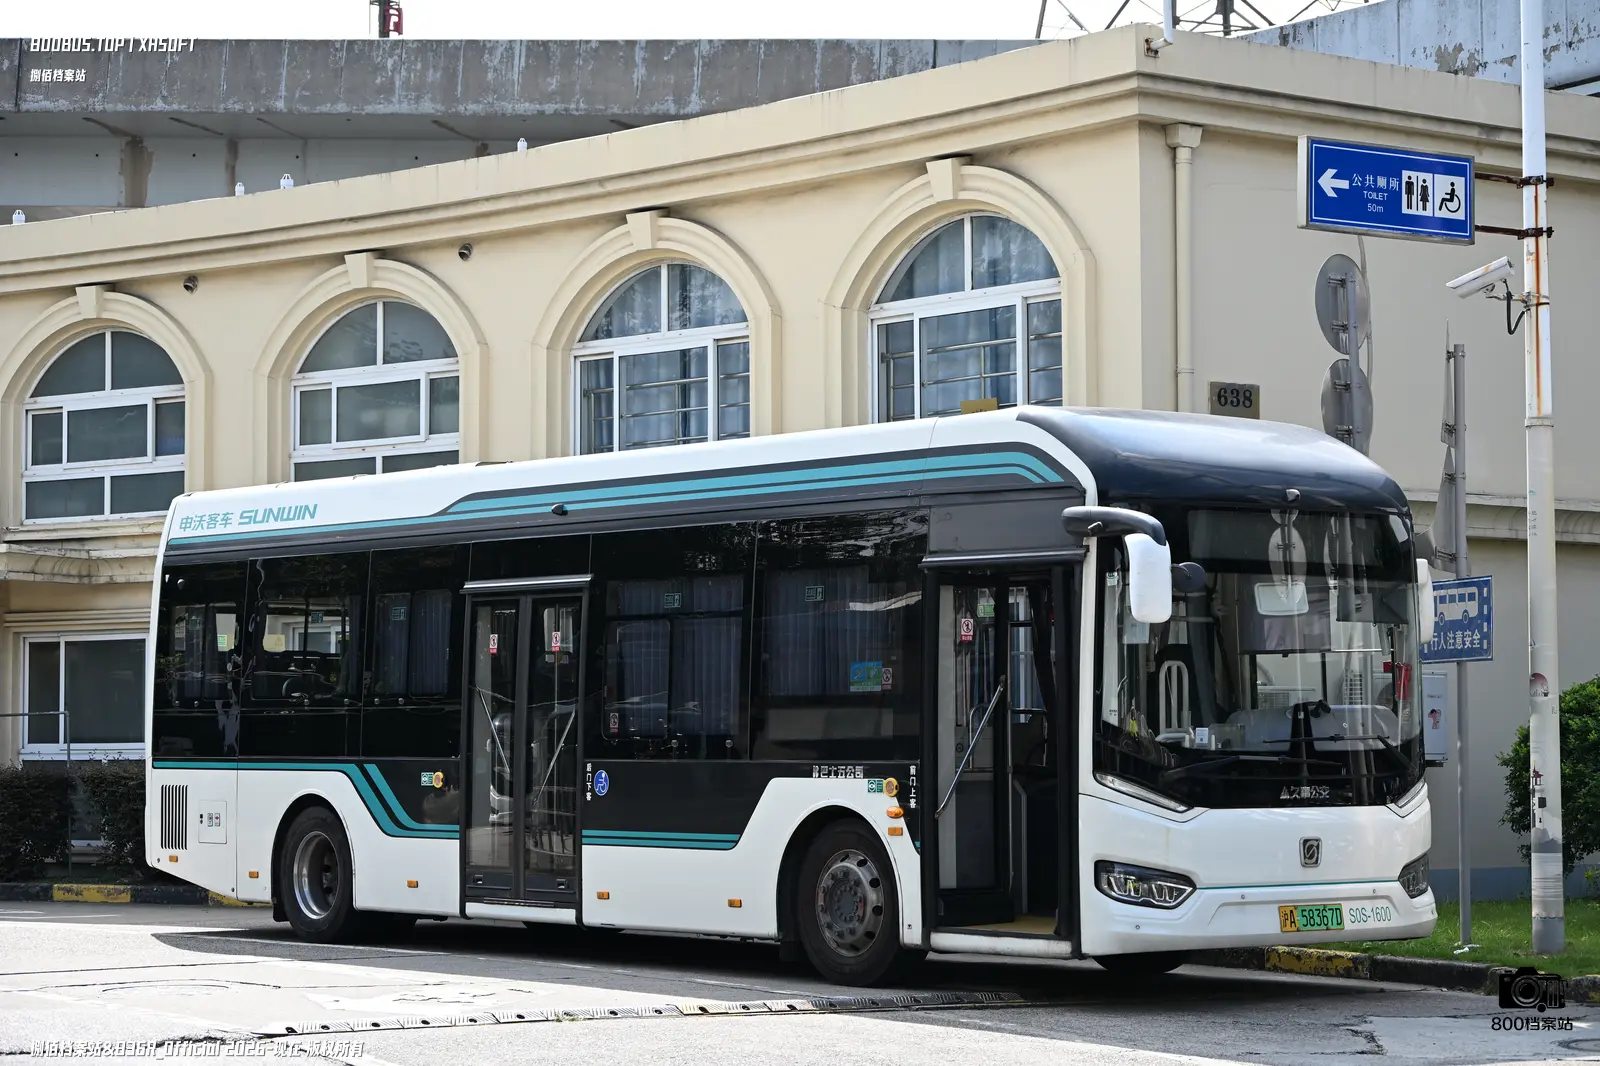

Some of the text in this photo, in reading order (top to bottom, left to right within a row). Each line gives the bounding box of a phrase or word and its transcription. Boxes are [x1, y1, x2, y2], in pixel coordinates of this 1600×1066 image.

[1352, 173, 1400, 191] 公共厕所
[1363, 190, 1388, 201] TOILET
[1367, 203, 1384, 213] 50m
[1217, 387, 1253, 408] 638
[179, 511, 234, 532] 申沃客车
[237, 503, 318, 526] SUNWIN
[1430, 629, 1481, 651] 行人注意安全
